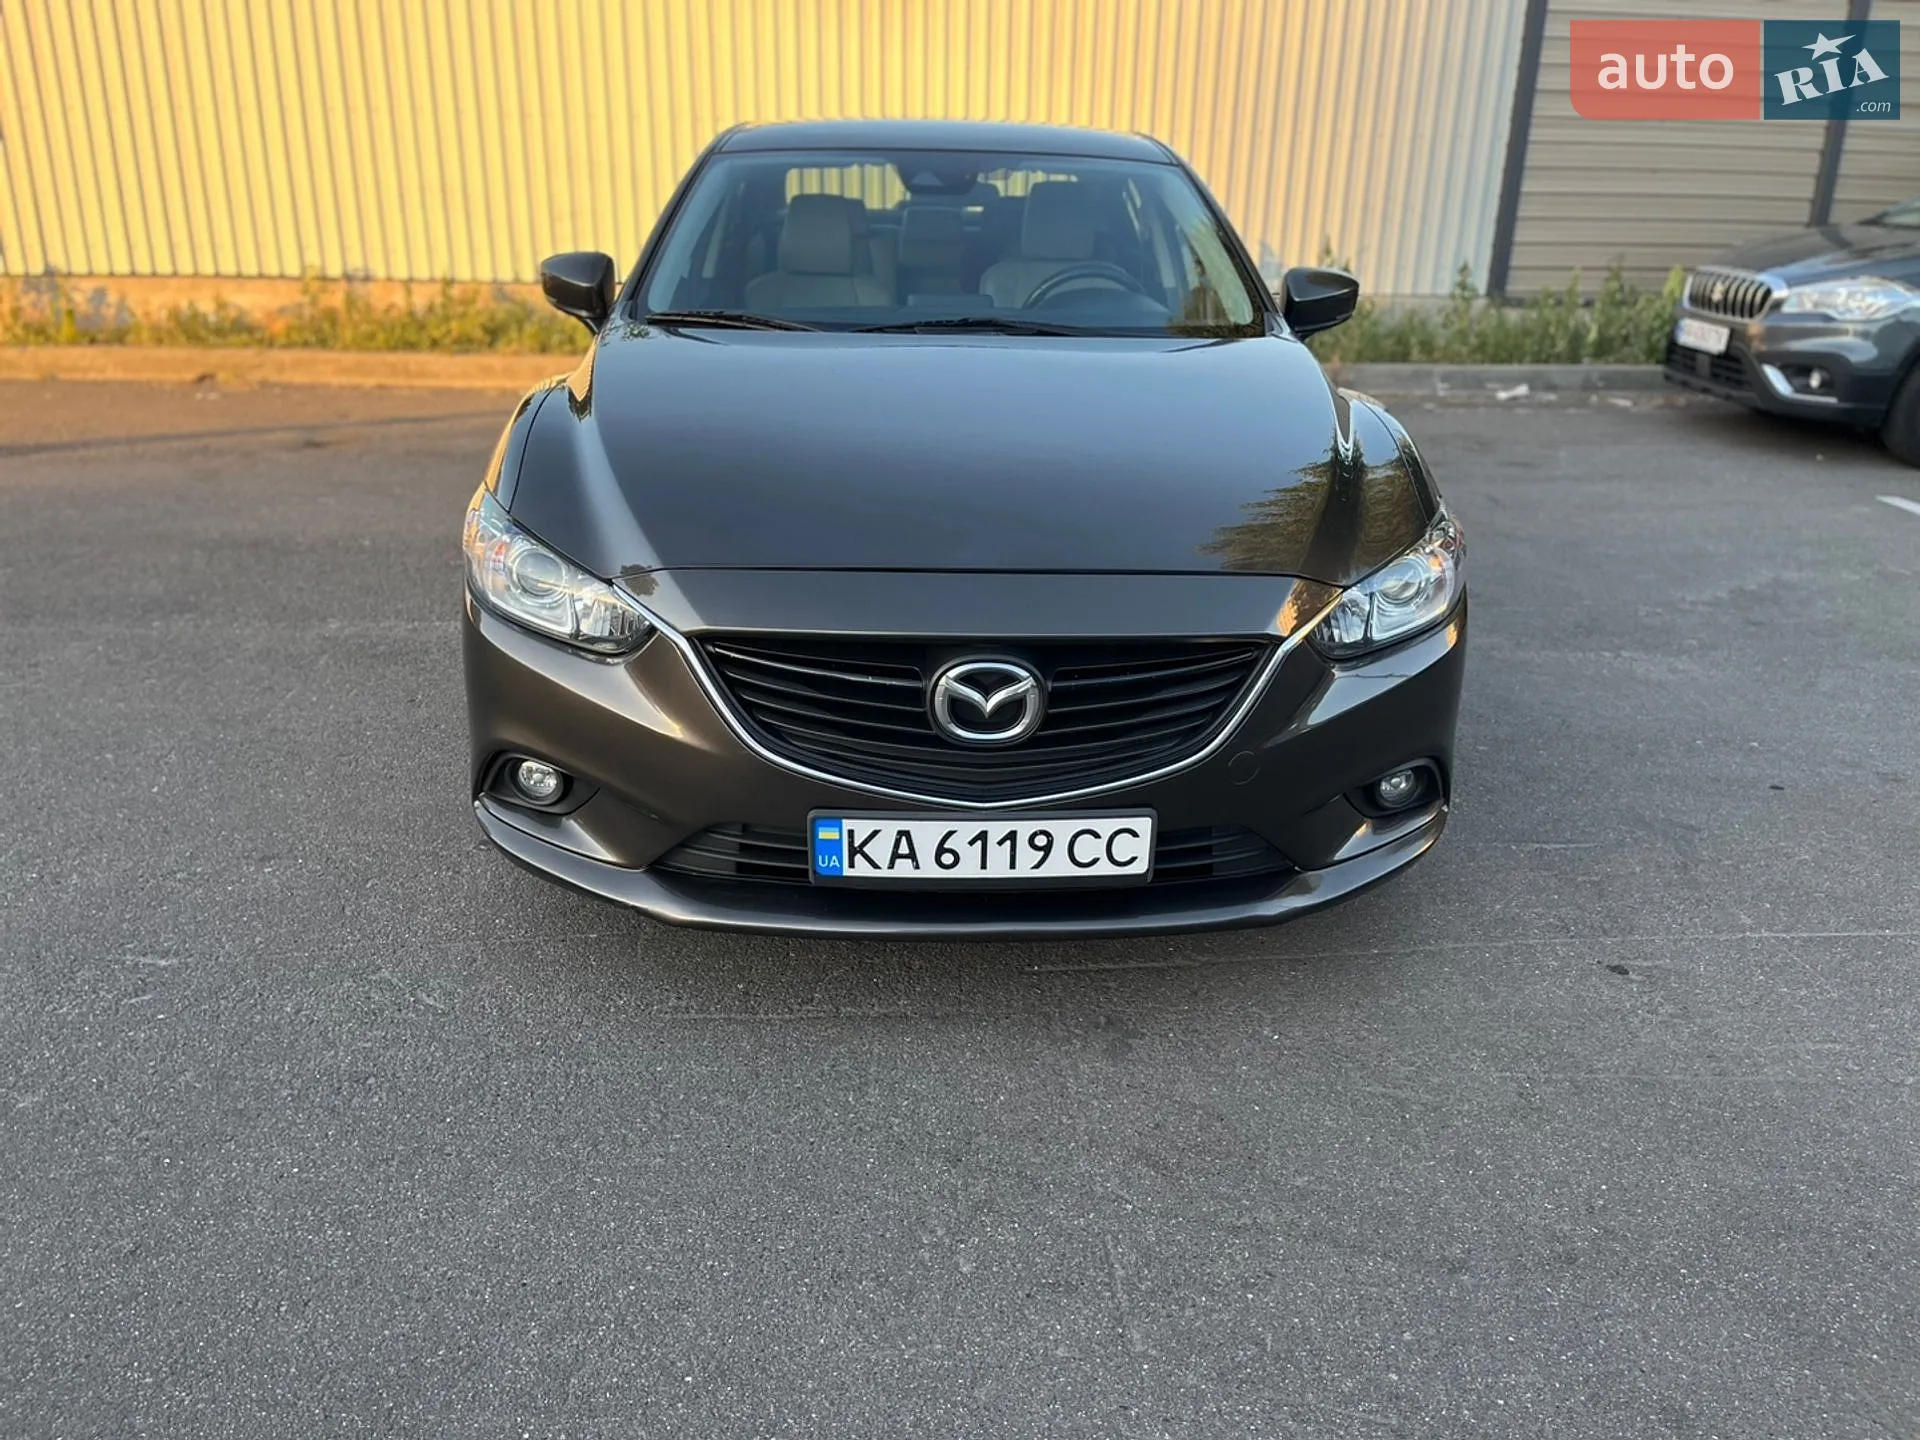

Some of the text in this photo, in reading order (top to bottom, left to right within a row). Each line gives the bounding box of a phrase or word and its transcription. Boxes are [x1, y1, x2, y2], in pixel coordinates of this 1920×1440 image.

[817, 854, 840, 868] UA
[847, 827, 1141, 870] KA 6119 CC
